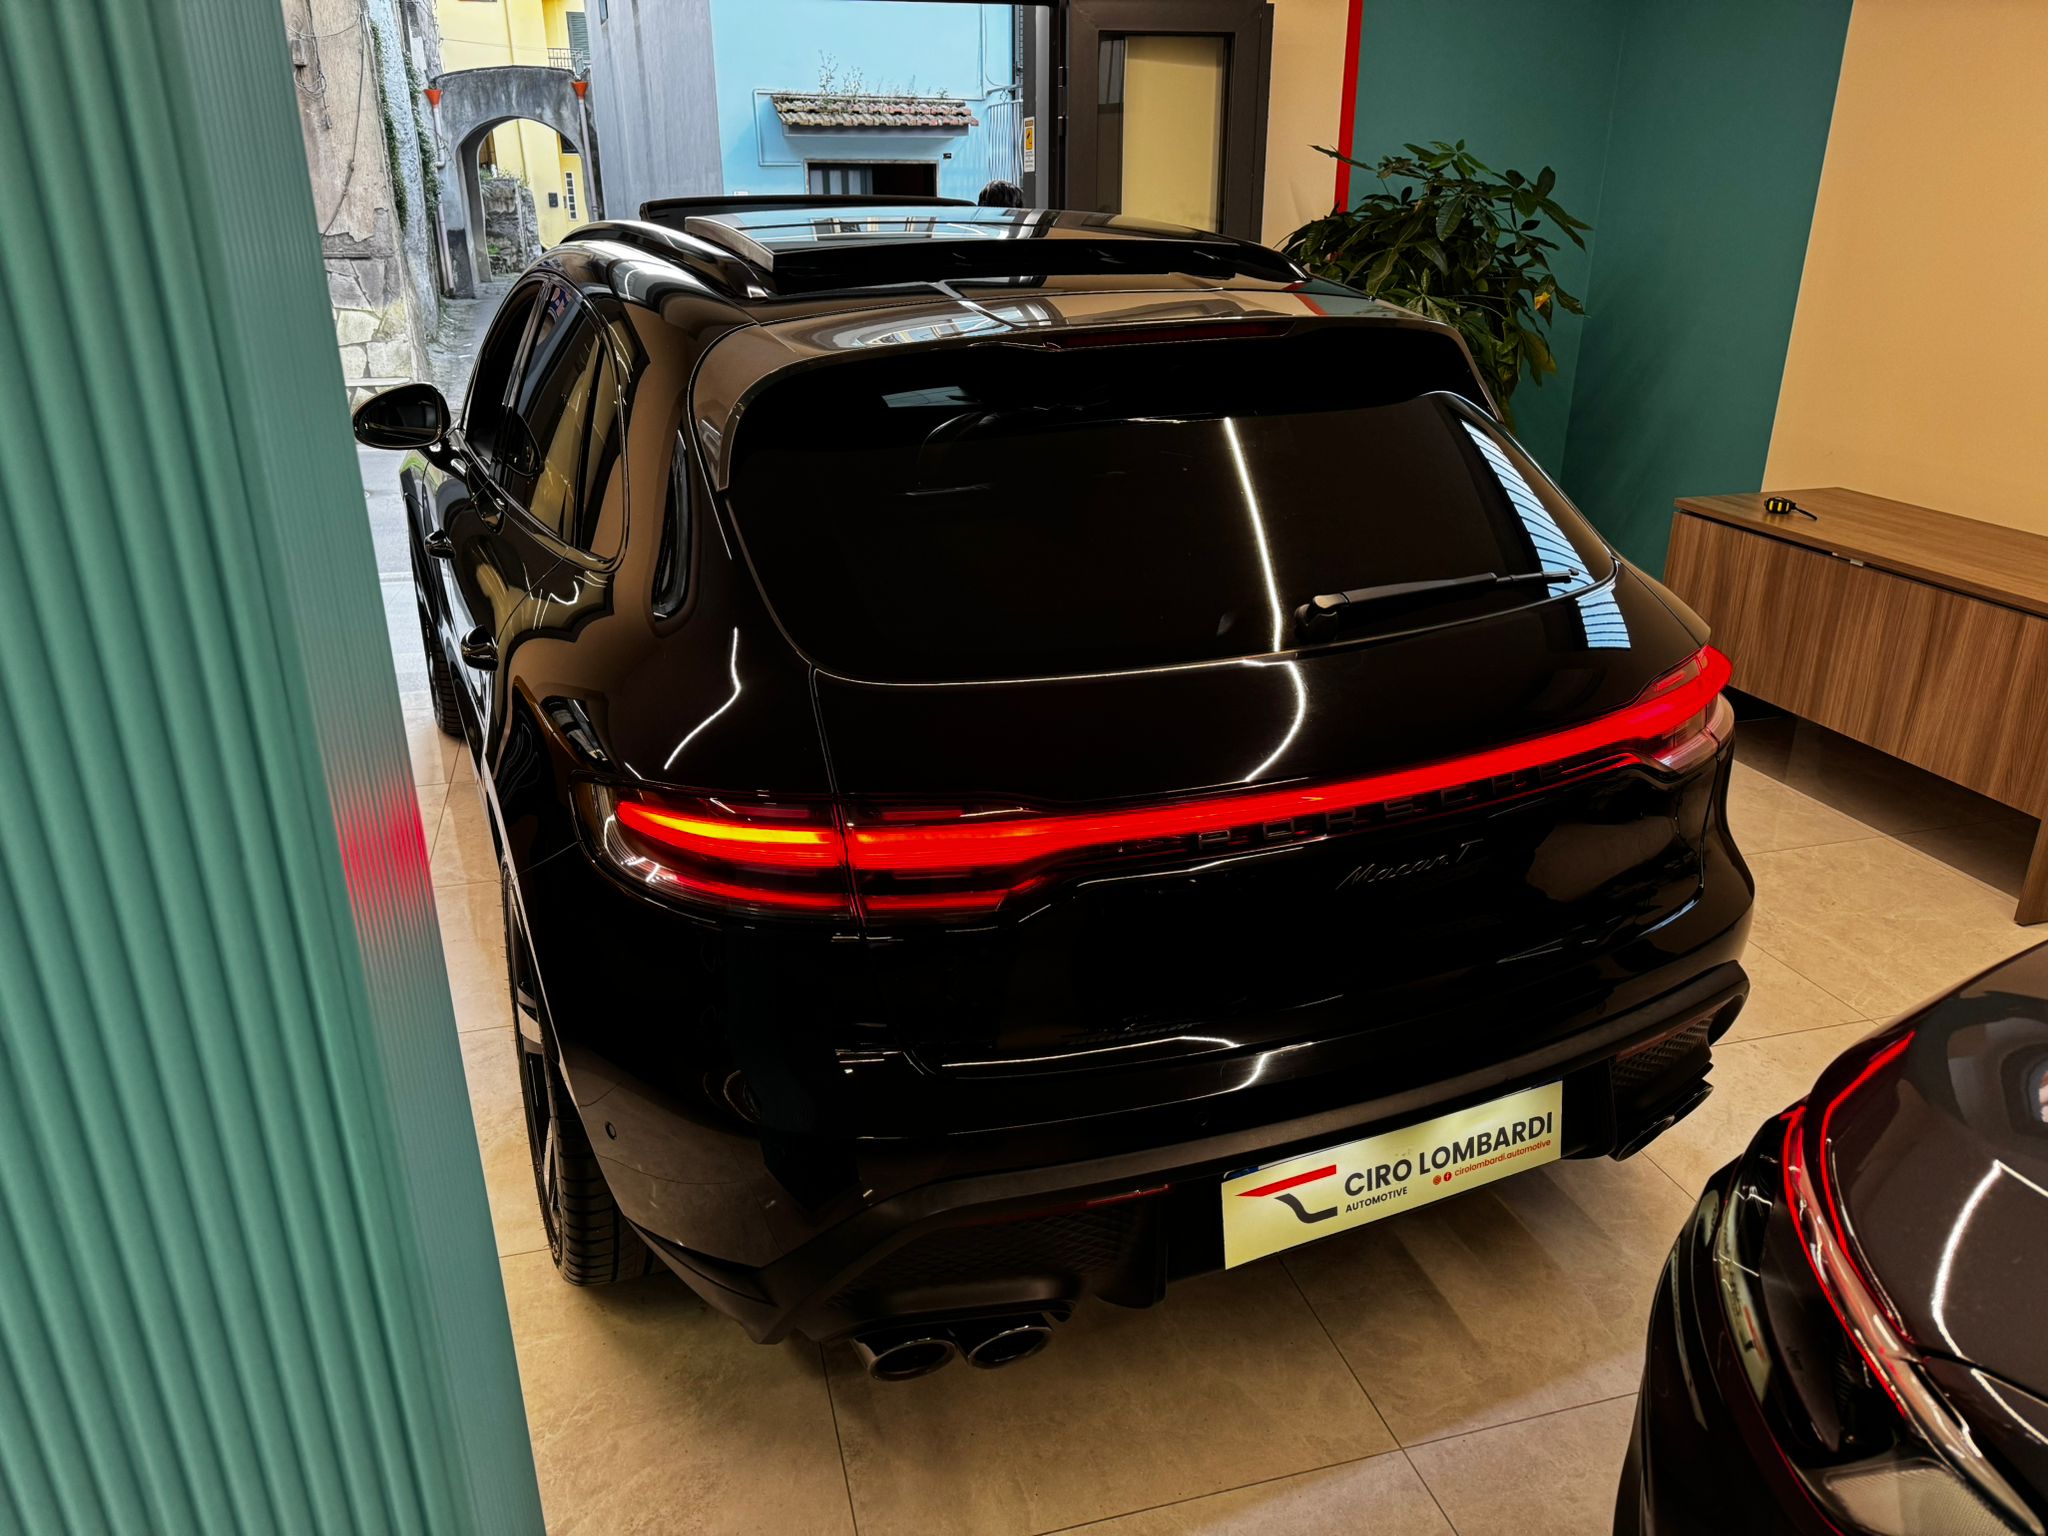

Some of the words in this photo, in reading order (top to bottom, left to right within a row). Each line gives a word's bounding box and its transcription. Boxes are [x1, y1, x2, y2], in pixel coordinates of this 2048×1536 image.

[1198, 766, 1560, 850] PORSCHE
[1335, 854, 1448, 892] Macan
[1456, 837, 1485, 864] T
[1344, 1159, 1412, 1197] CIRO
[1419, 1112, 1553, 1175] LOMBARDI
[1454, 1140, 1551, 1177] cirolombardi.automotive
[1345, 1187, 1408, 1213] AUTOMOTIVE
